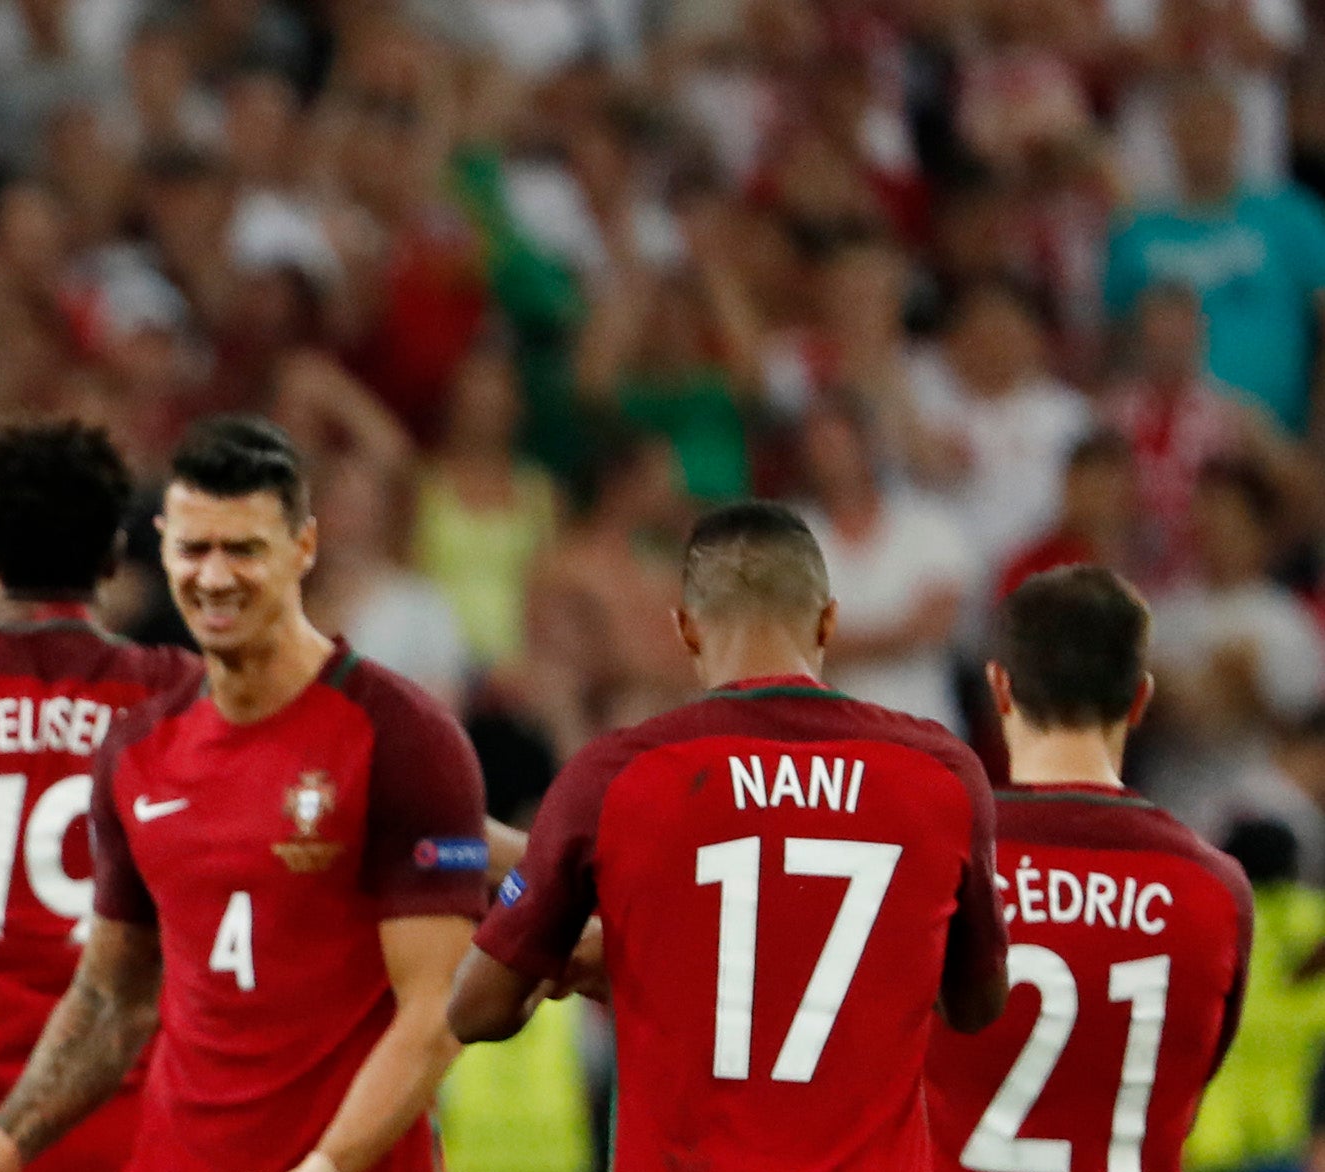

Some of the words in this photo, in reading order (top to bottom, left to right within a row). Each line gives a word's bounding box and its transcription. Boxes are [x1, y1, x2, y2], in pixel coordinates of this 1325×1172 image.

[728, 754, 865, 814] NANI
[209, 891, 255, 992] 4
[696, 835, 904, 1083] 17
